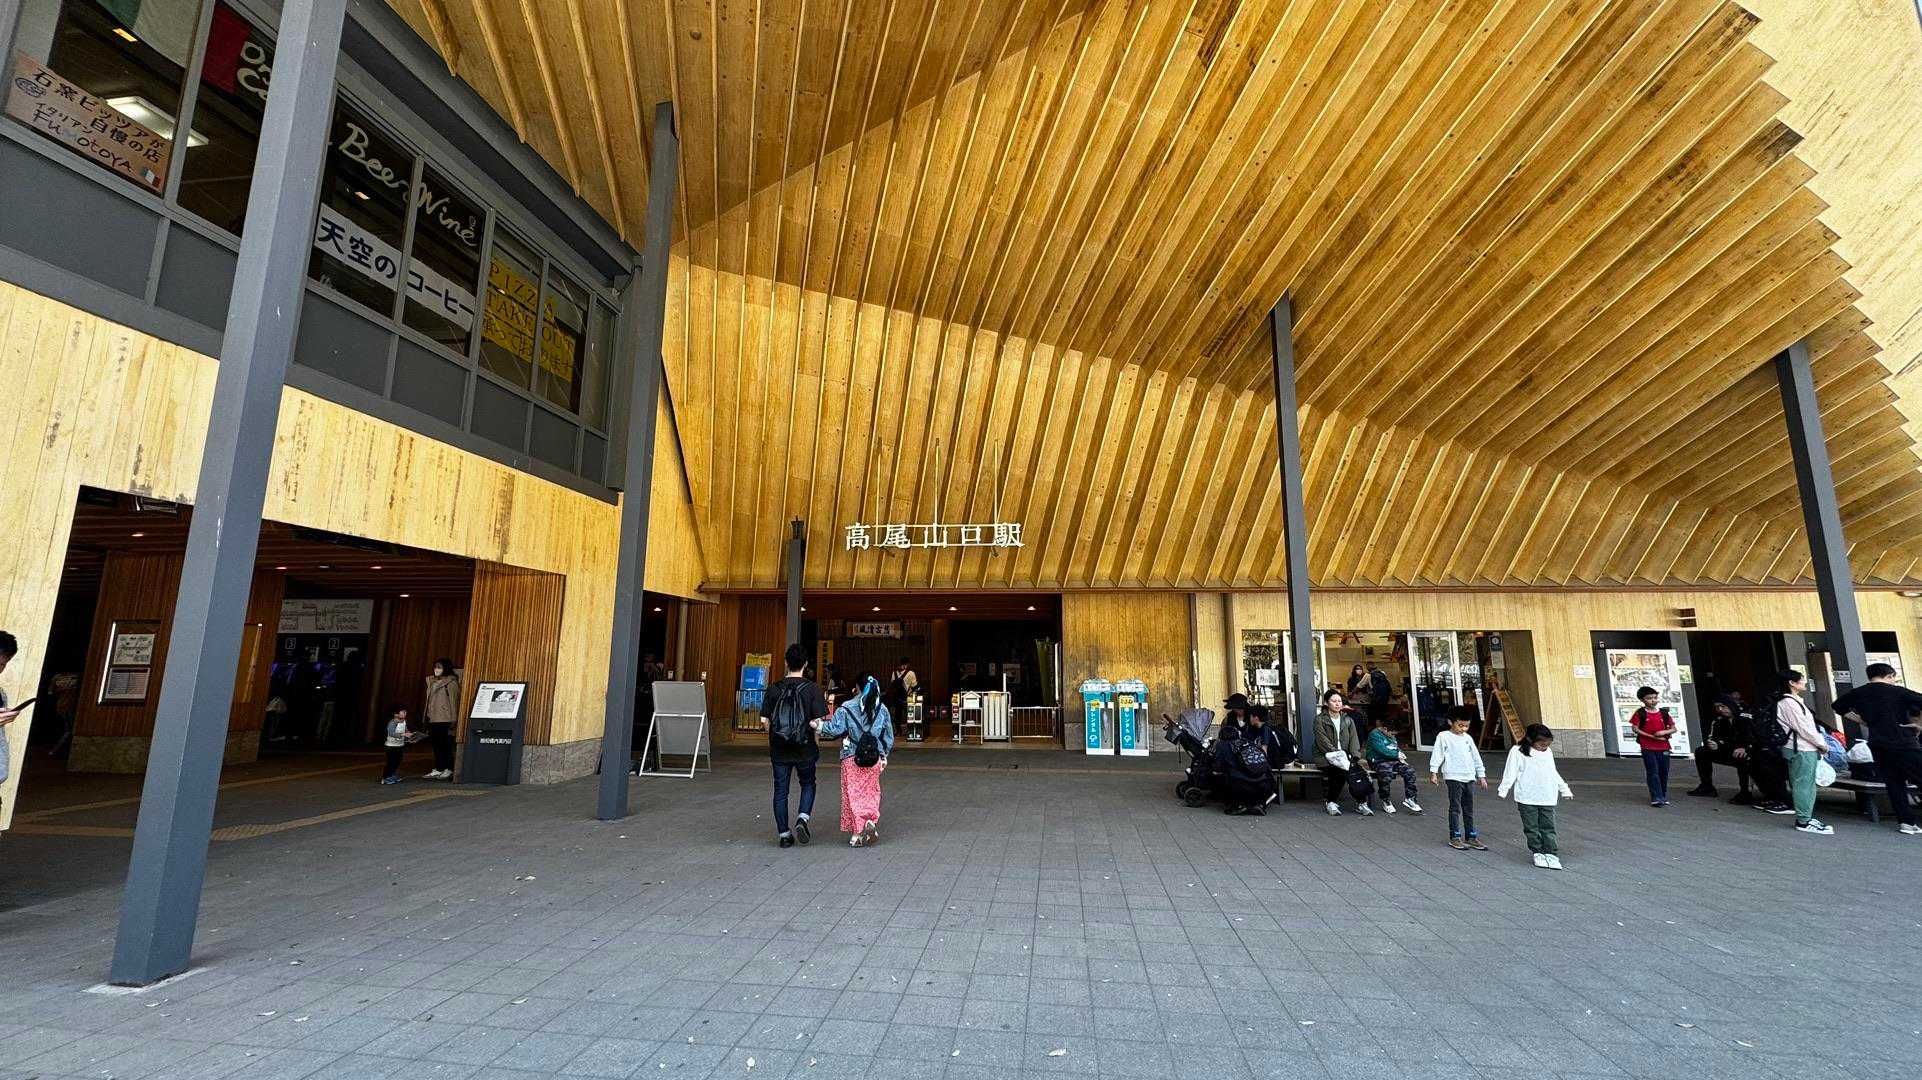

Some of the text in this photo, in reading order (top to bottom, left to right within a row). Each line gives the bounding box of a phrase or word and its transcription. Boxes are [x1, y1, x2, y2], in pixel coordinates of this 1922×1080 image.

[35, 102, 93, 134] イタリアン
[91, 117, 163, 163] 自慢の店
[317, 216, 475, 315] 天空の コーヒー
[844, 522, 1026, 551] 高尾山口駅
